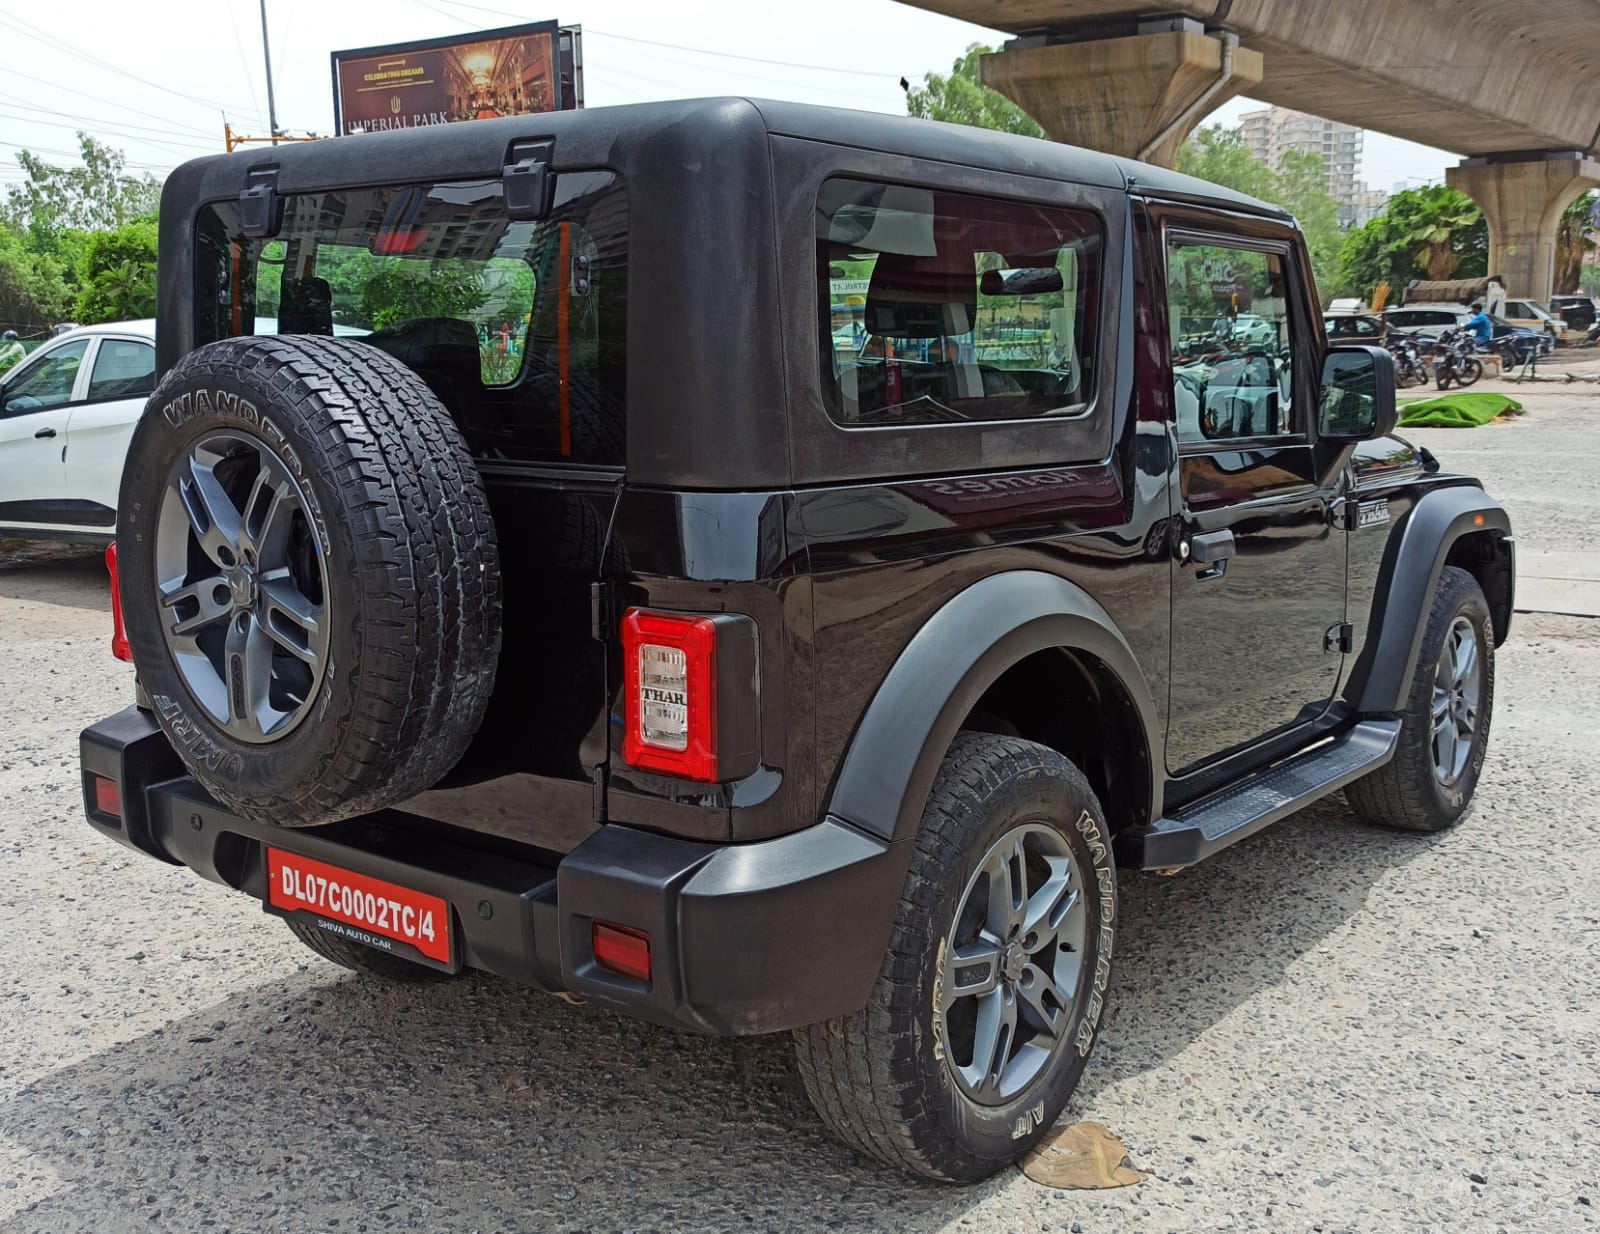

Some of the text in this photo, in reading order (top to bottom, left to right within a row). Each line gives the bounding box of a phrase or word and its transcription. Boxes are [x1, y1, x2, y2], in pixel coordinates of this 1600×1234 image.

[348, 112, 448, 133] IMPERIAL PARK
[641, 687, 687, 706] THAR
[318, 918, 392, 950] SHIVA AUTO CAR
[1075, 808, 1116, 1058] WANDERER
